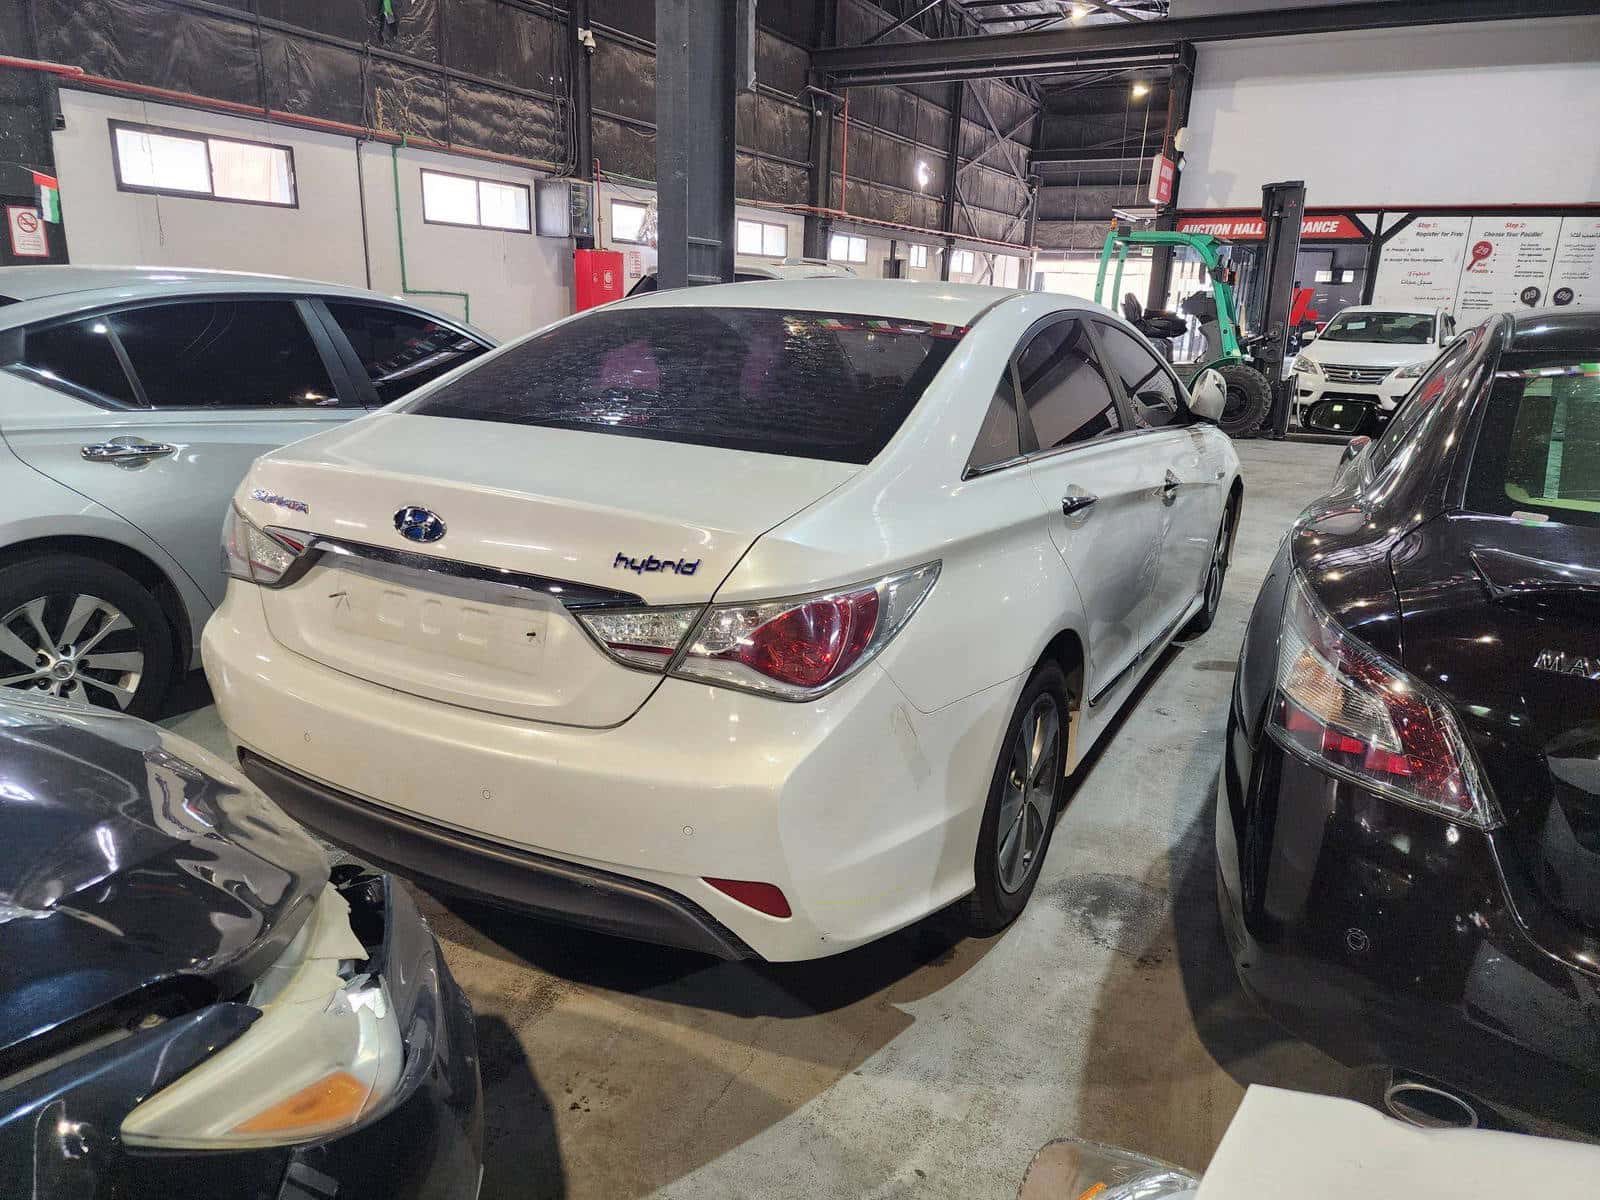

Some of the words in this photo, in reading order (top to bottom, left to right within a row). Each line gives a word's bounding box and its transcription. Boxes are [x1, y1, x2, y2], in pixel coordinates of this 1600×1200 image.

[1182, 223, 1231, 235] AUCTION
[1233, 222, 1263, 235] HALL
[1505, 222, 1519, 230] Step
[613, 551, 702, 576] hybrid
